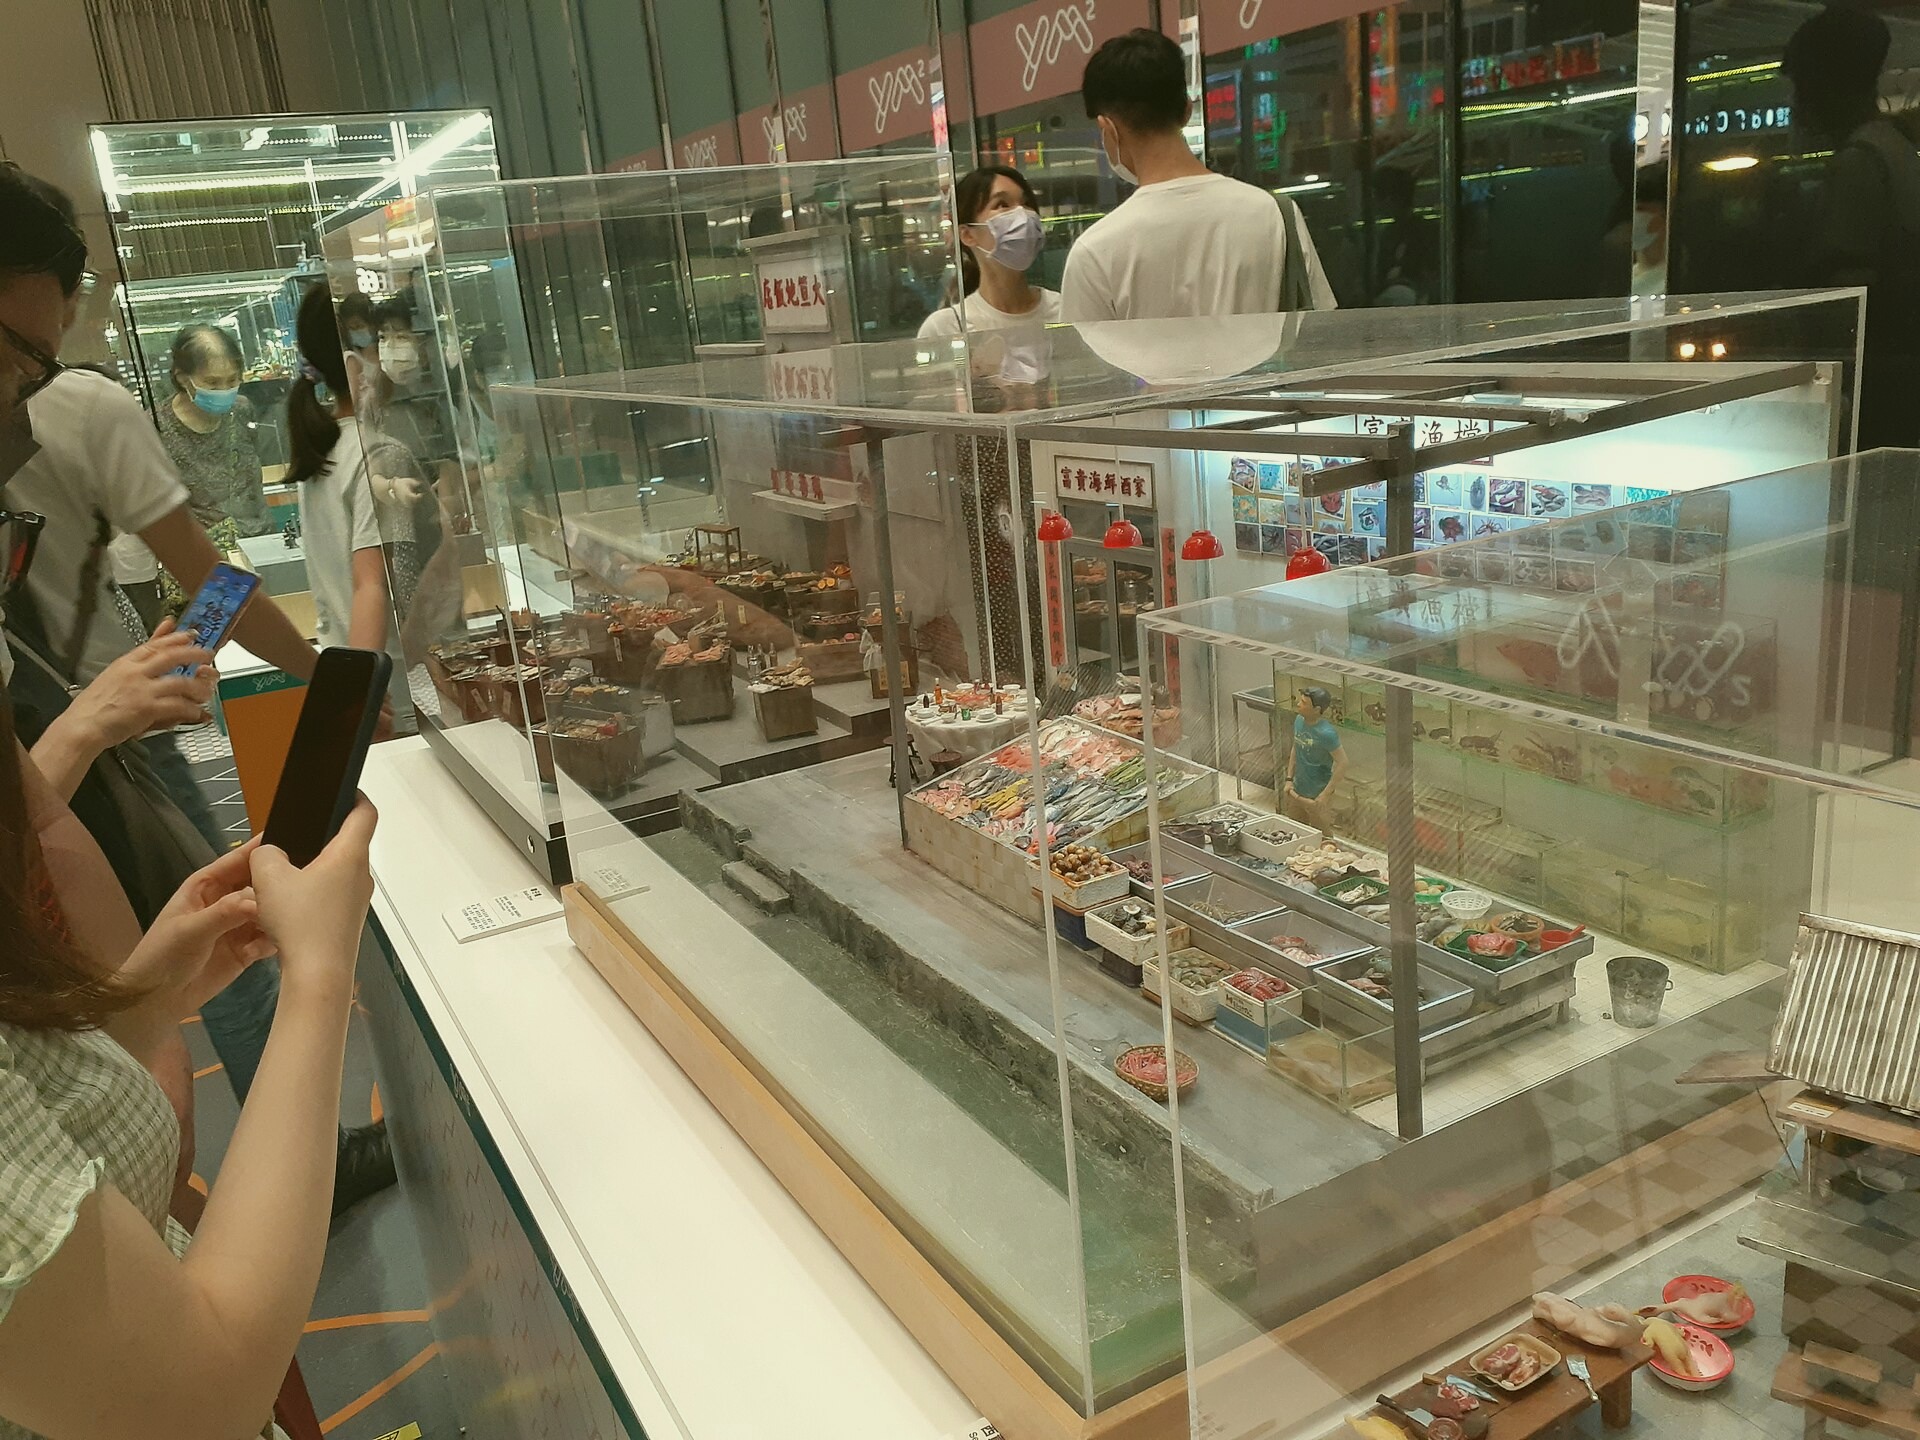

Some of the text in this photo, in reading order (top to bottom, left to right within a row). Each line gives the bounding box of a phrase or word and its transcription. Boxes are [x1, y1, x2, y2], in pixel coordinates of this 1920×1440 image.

[1060, 465, 1147, 498] 富貴海鮮酒家
